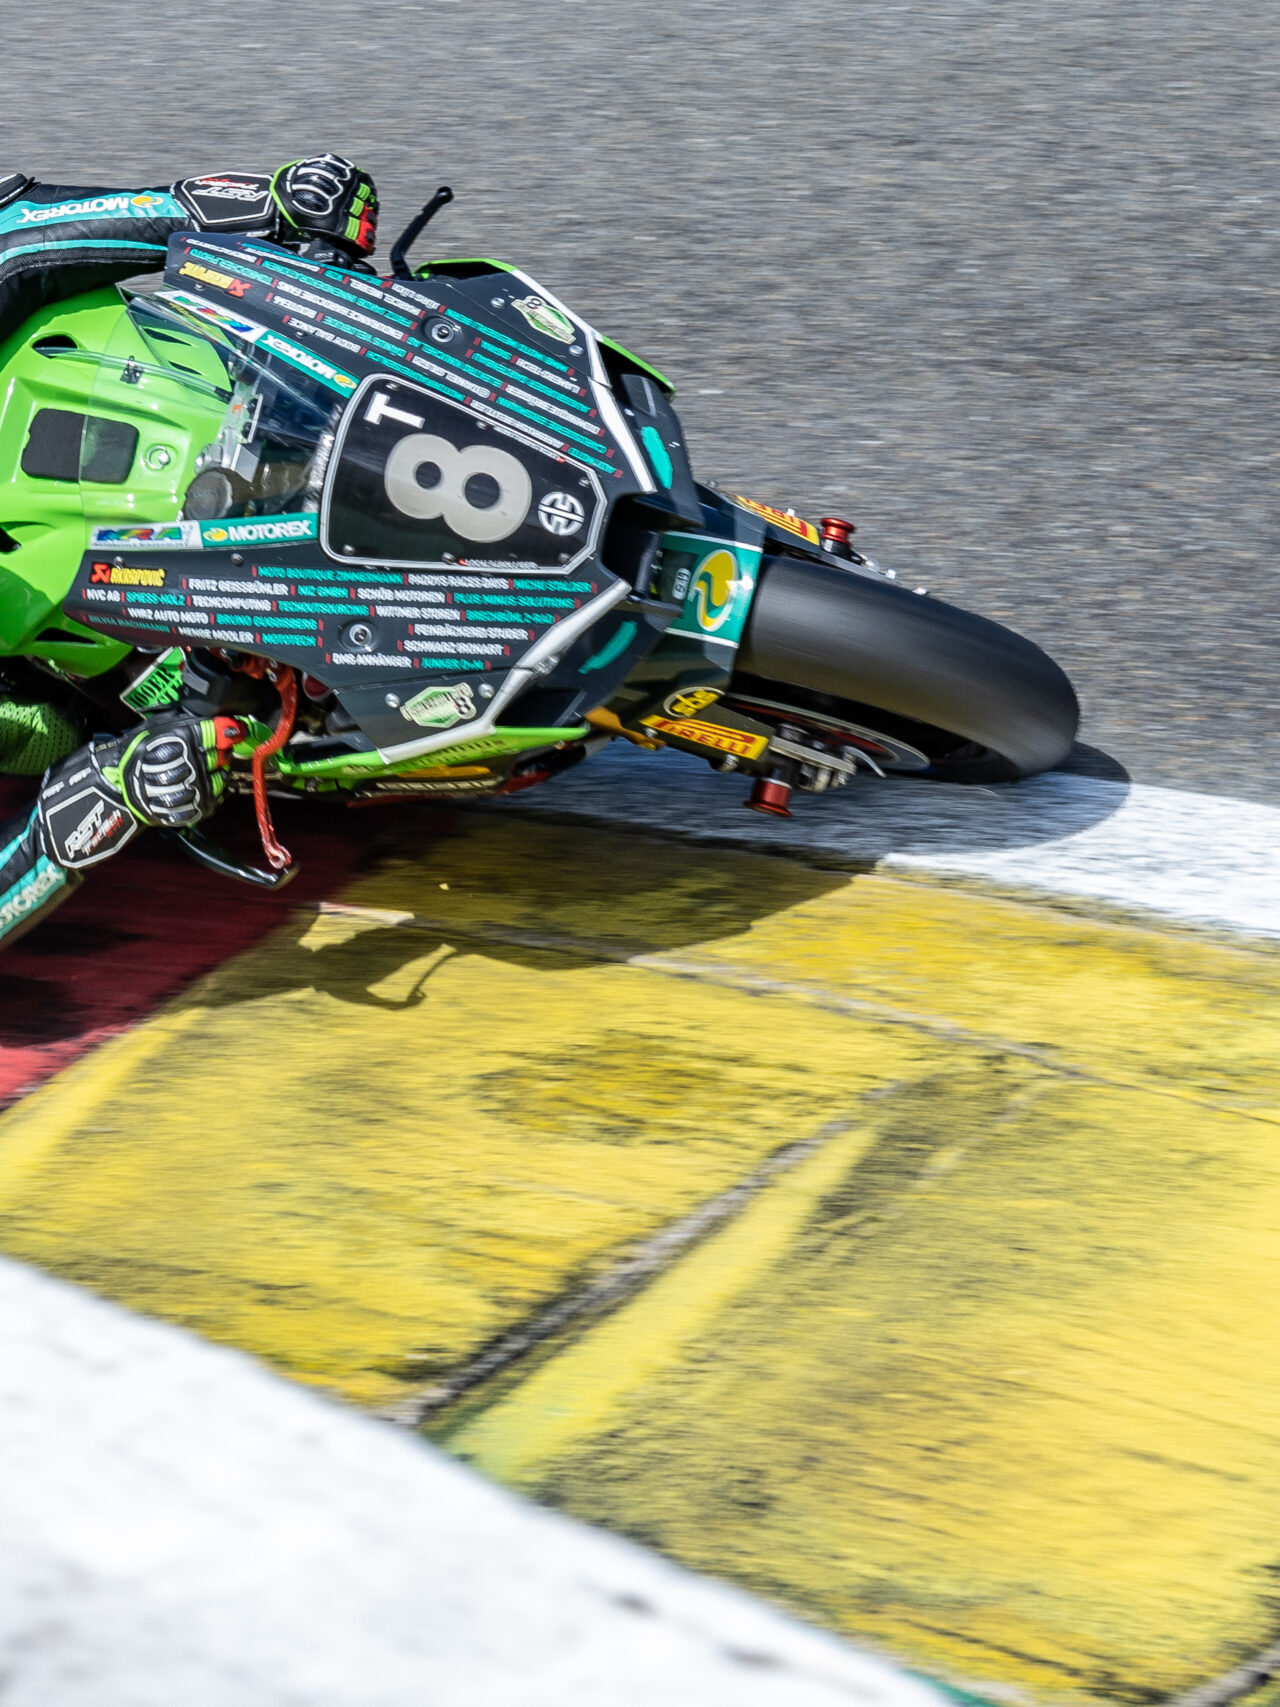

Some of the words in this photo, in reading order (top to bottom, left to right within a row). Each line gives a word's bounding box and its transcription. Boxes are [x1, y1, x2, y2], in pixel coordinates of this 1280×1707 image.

[191, 184, 266, 202] RST
[22, 195, 130, 224] MOTOREX
[259, 332, 338, 379] MOTOREX
[364, 392, 425, 428] T
[384, 433, 532, 542] 8
[228, 519, 314, 542] MOTOREX
[189, 579, 216, 591] FRITZ
[63, 799, 106, 859] RST
